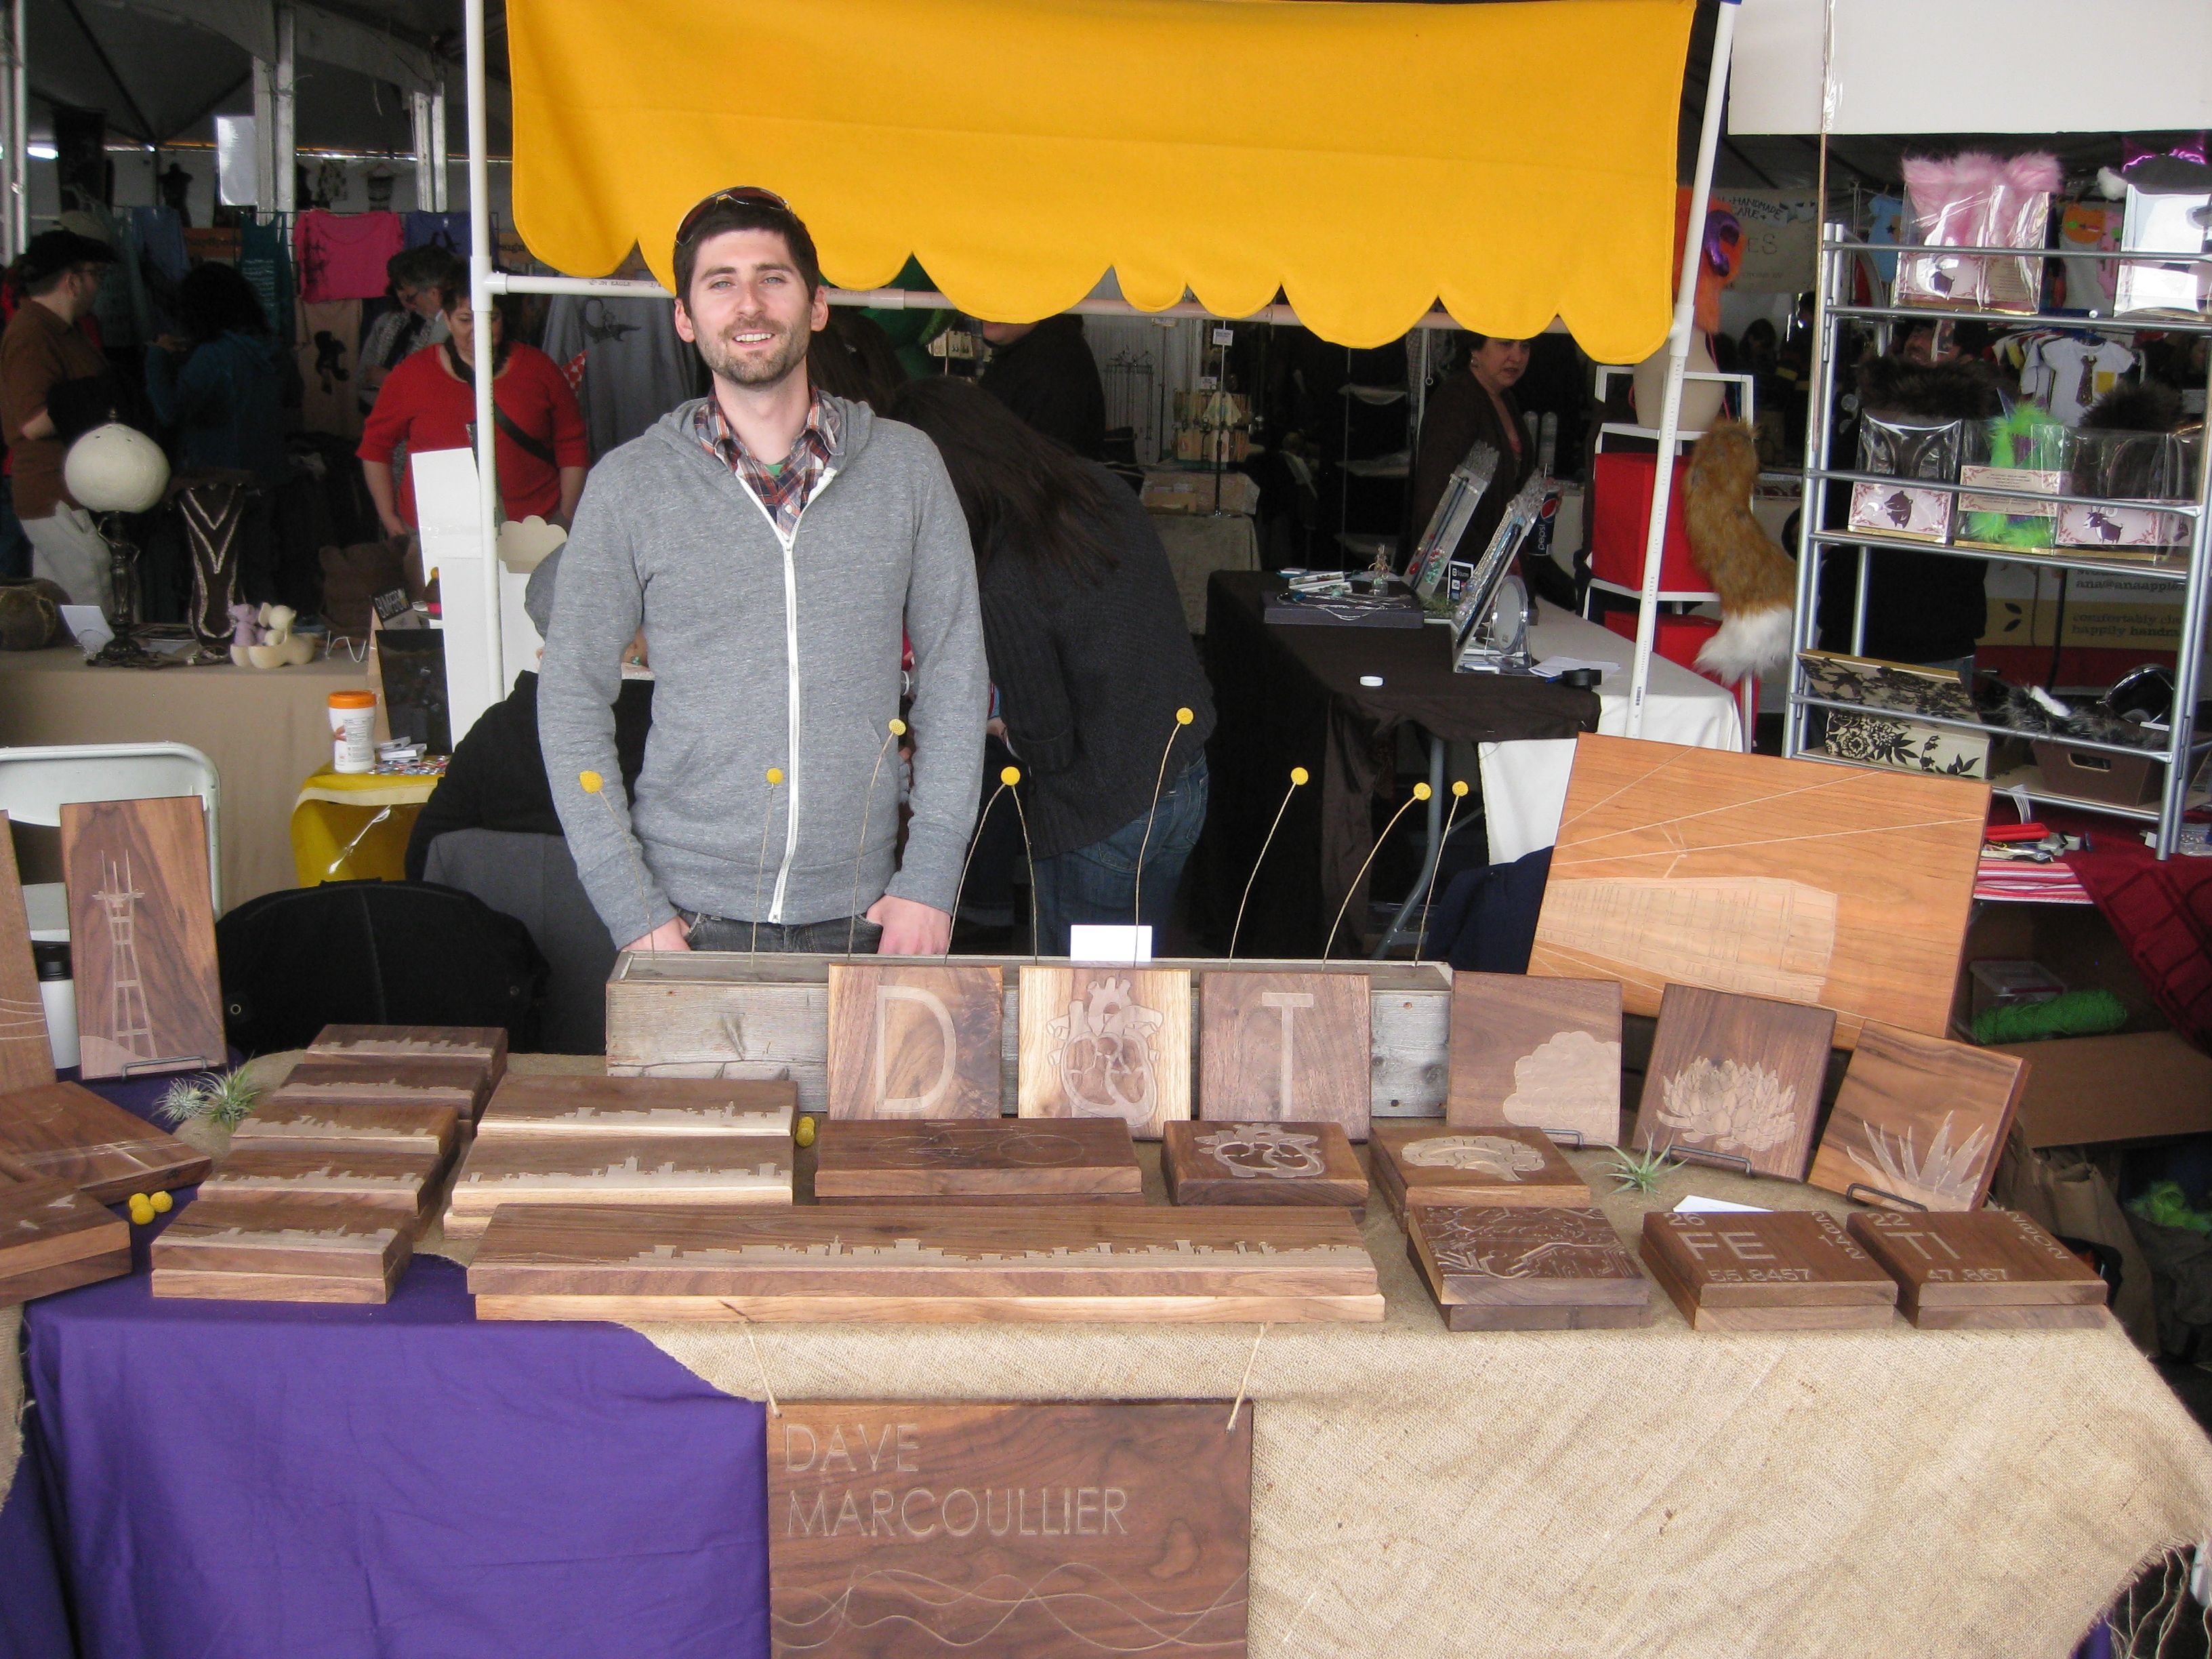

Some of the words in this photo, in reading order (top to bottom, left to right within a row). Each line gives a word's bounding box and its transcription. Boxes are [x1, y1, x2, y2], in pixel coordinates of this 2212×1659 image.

[1733, 197, 1784, 220] HANDMADE
[1538, 524, 1547, 550] pepsi
[2072, 613, 2156, 626] comfortably
[2072, 624, 2127, 636] happily
[875, 985, 957, 1112] D
[1262, 992, 1313, 1120] T
[1663, 1212, 1706, 1226] 26
[1866, 1212, 1910, 1226] 22
[1677, 1231, 1776, 1261] FE
[1883, 1231, 1961, 1260] TI
[1707, 1269, 1810, 1282] 55.8457
[1927, 1268, 2009, 1282] 47.867
[783, 1423, 920, 1473] DAVE
[787, 1487, 1128, 1537] MARCOULLIER
